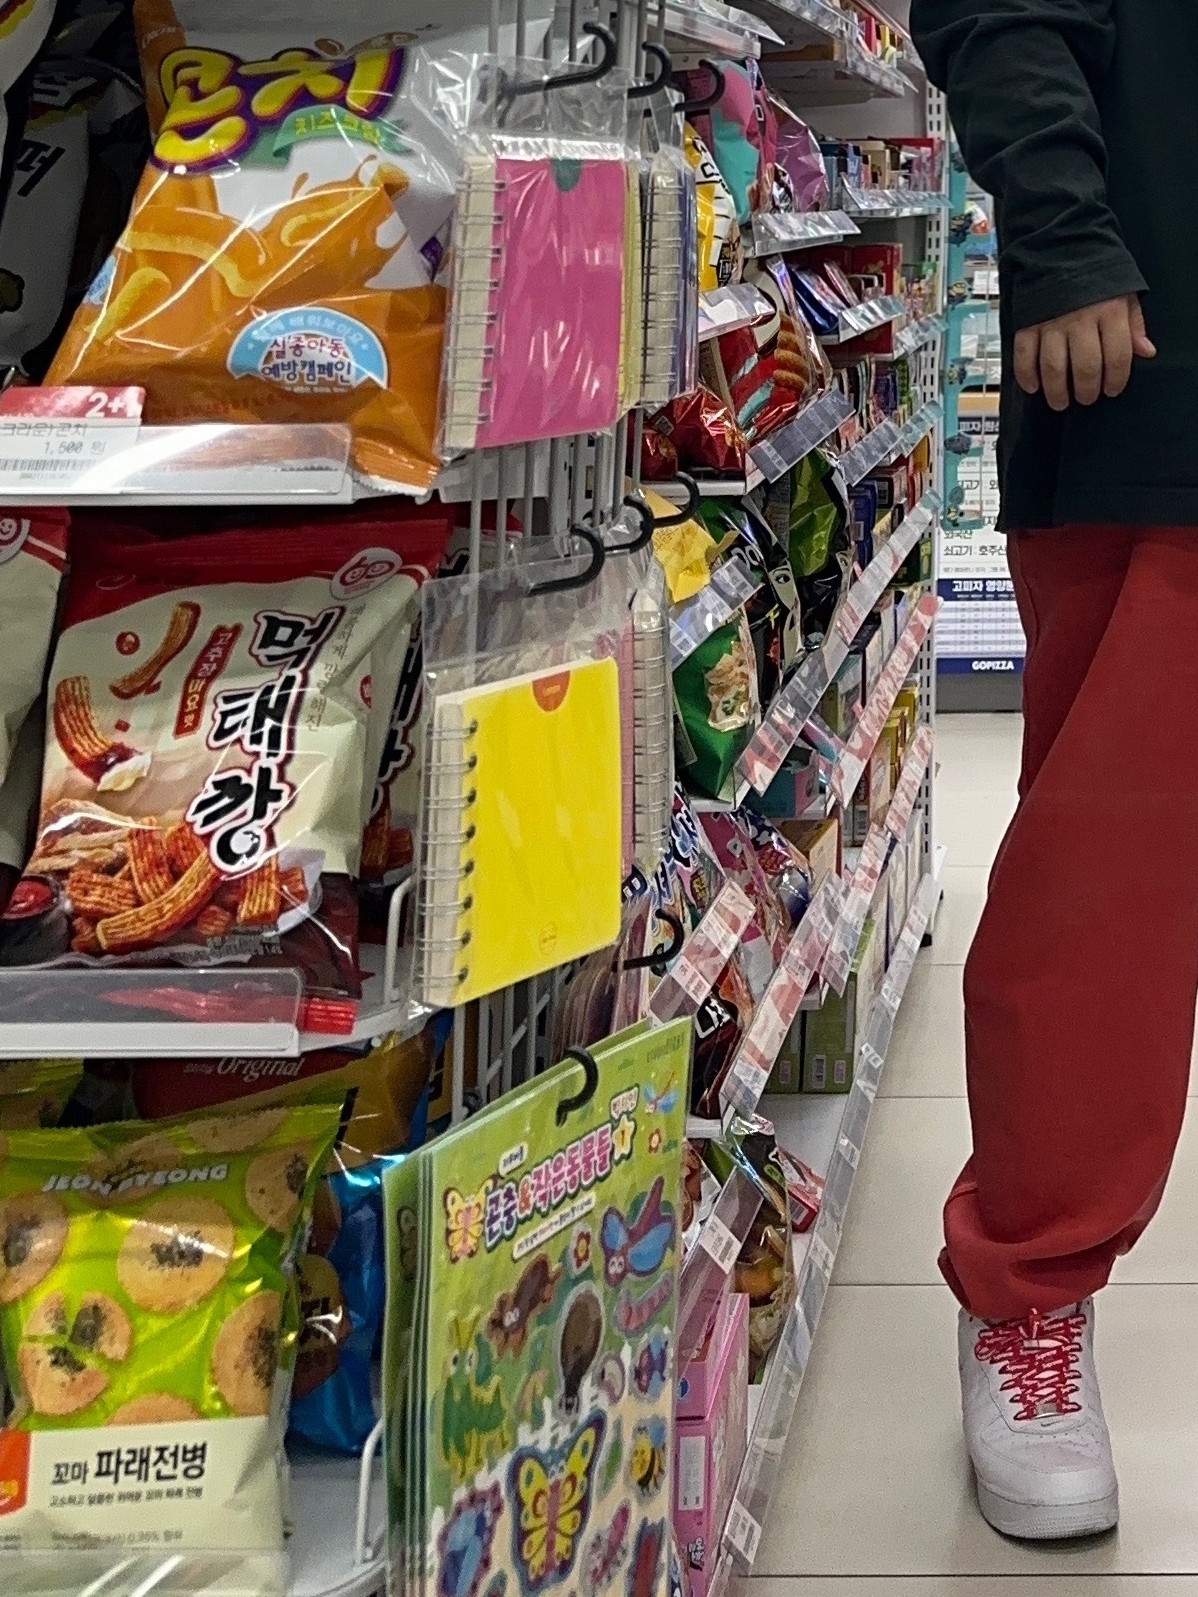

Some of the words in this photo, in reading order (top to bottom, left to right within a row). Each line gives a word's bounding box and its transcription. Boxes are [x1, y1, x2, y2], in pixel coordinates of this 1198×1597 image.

[971, 660, 1014, 671] GOPIZZA
[189, 610, 344, 867] 먹태깡
[217, 1056, 304, 1083] Original
[51, 1460, 88, 1485] 꼬마
[93, 1440, 207, 1485] 파래전병
